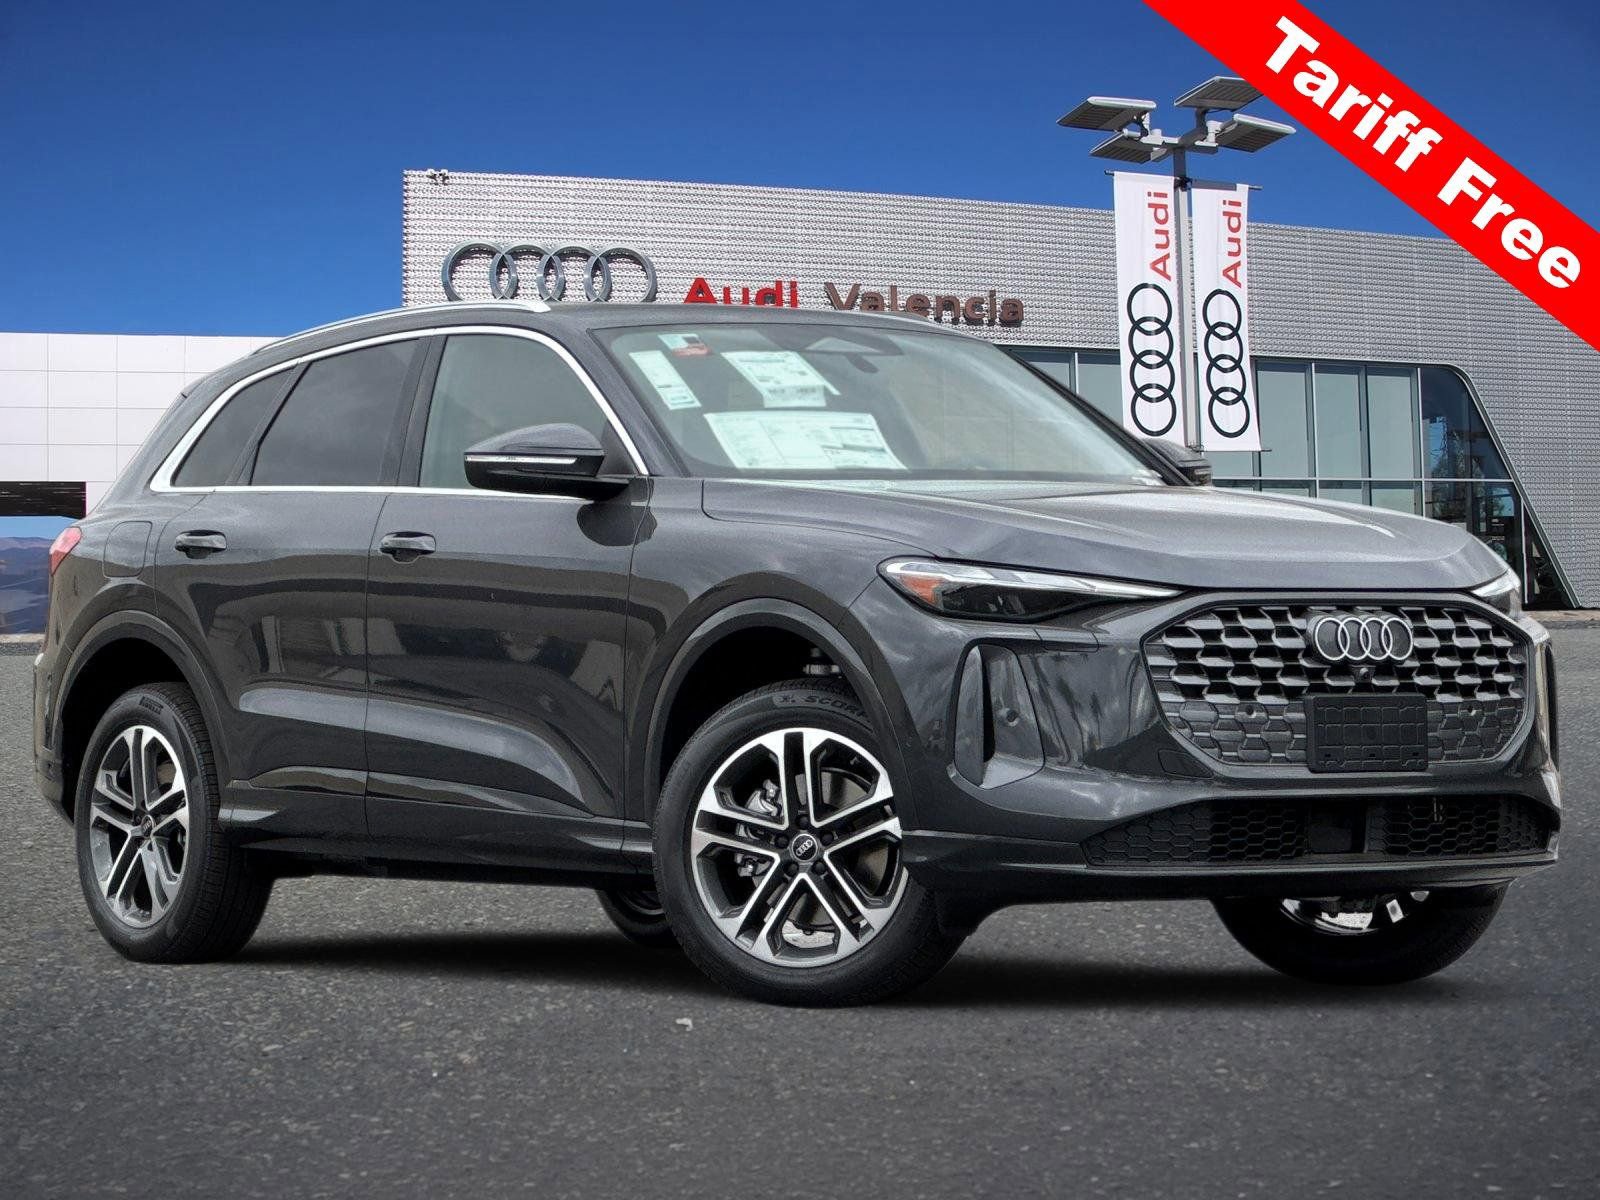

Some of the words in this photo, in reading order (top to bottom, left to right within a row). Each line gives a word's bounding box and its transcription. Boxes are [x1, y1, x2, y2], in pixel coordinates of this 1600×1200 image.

[1147, 191, 1172, 282] Audi
[1222, 199, 1242, 289] Audi
[683, 277, 798, 308] Audi
[824, 282, 1024, 326] Valencia
